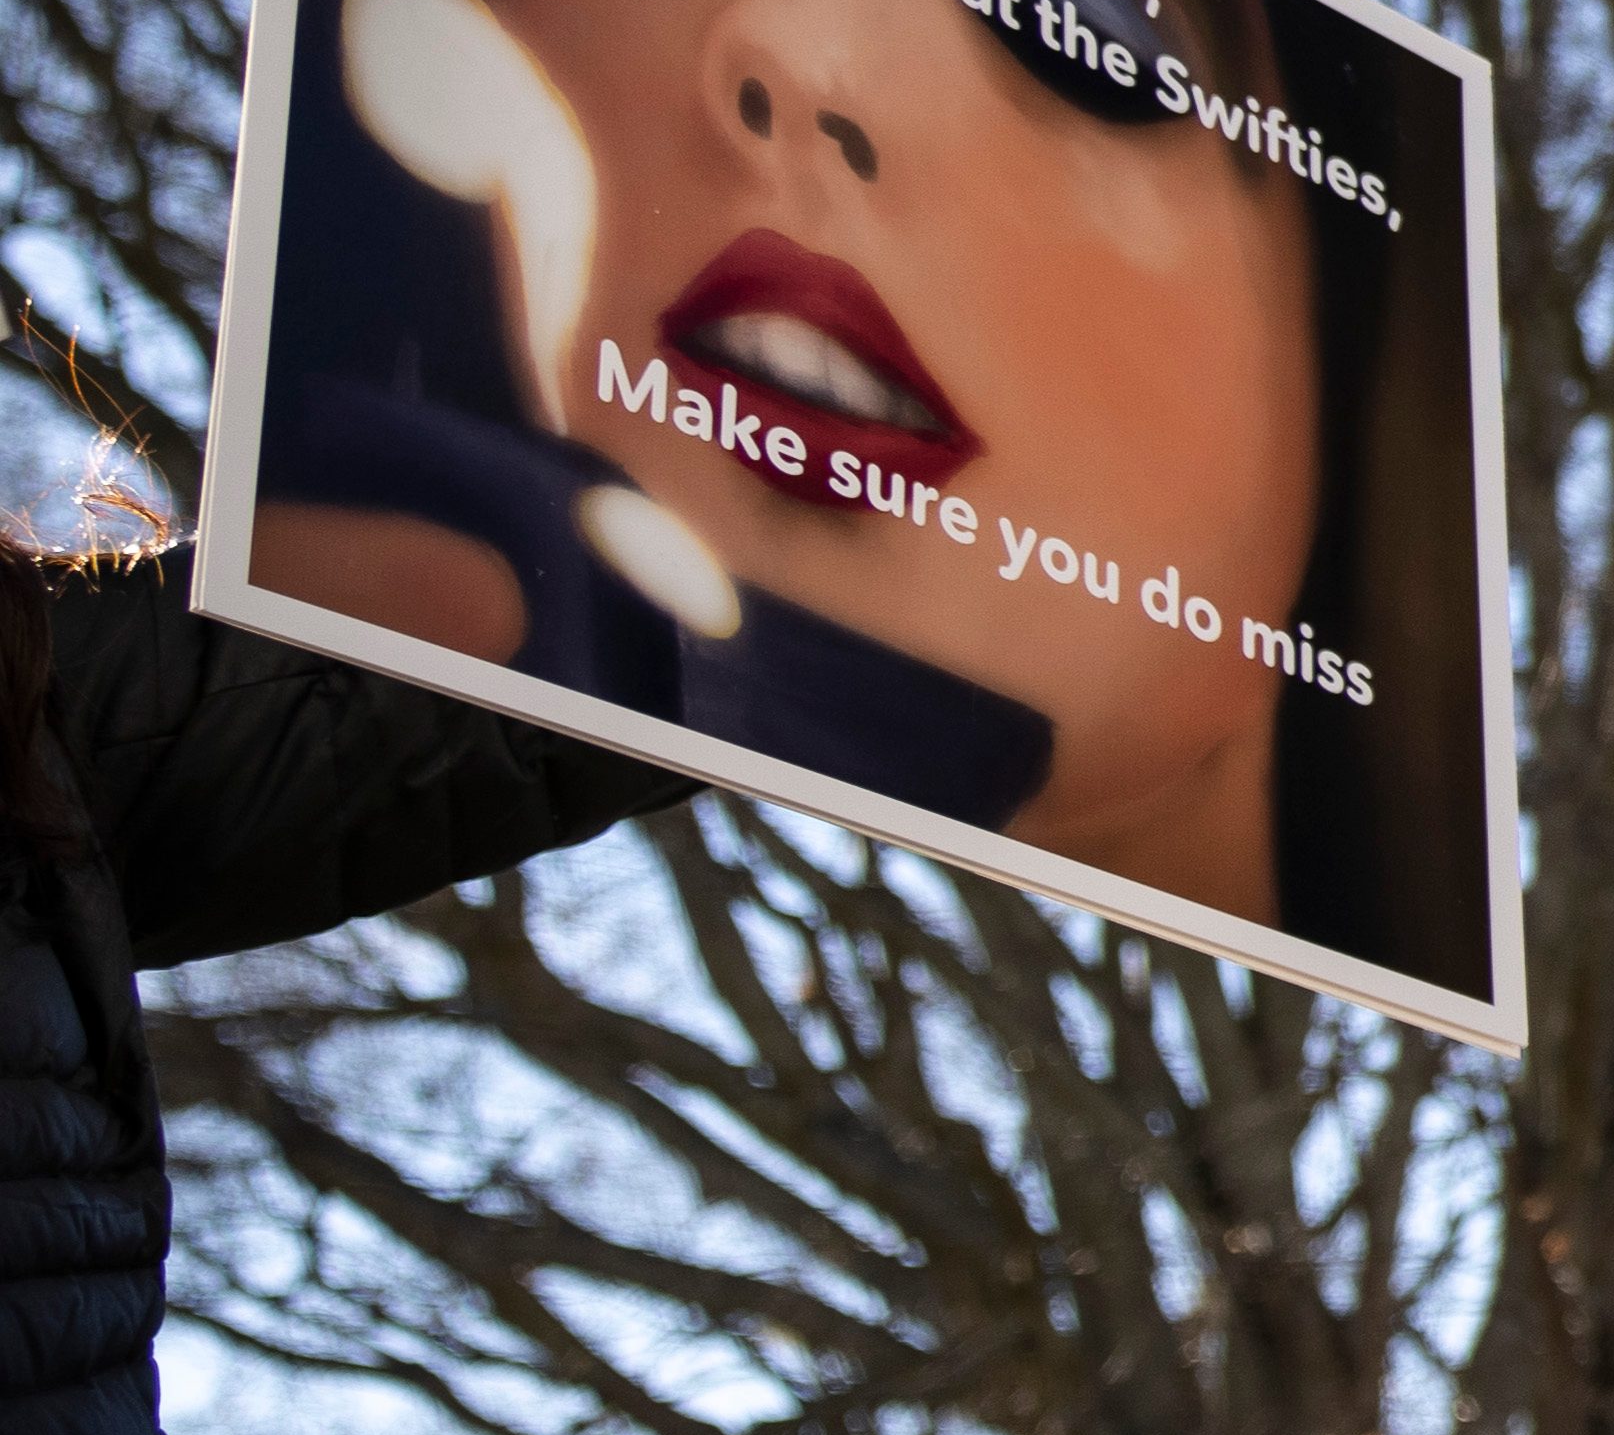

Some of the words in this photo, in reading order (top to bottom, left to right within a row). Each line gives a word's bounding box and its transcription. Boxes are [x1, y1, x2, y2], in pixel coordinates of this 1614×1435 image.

[1154, 53, 1403, 233] Swifties,
[596, 337, 808, 477] Make
[827, 449, 980, 546] sure
[997, 515, 1121, 606] you
[1140, 565, 1223, 644] do
[1240, 615, 1375, 707] miss
